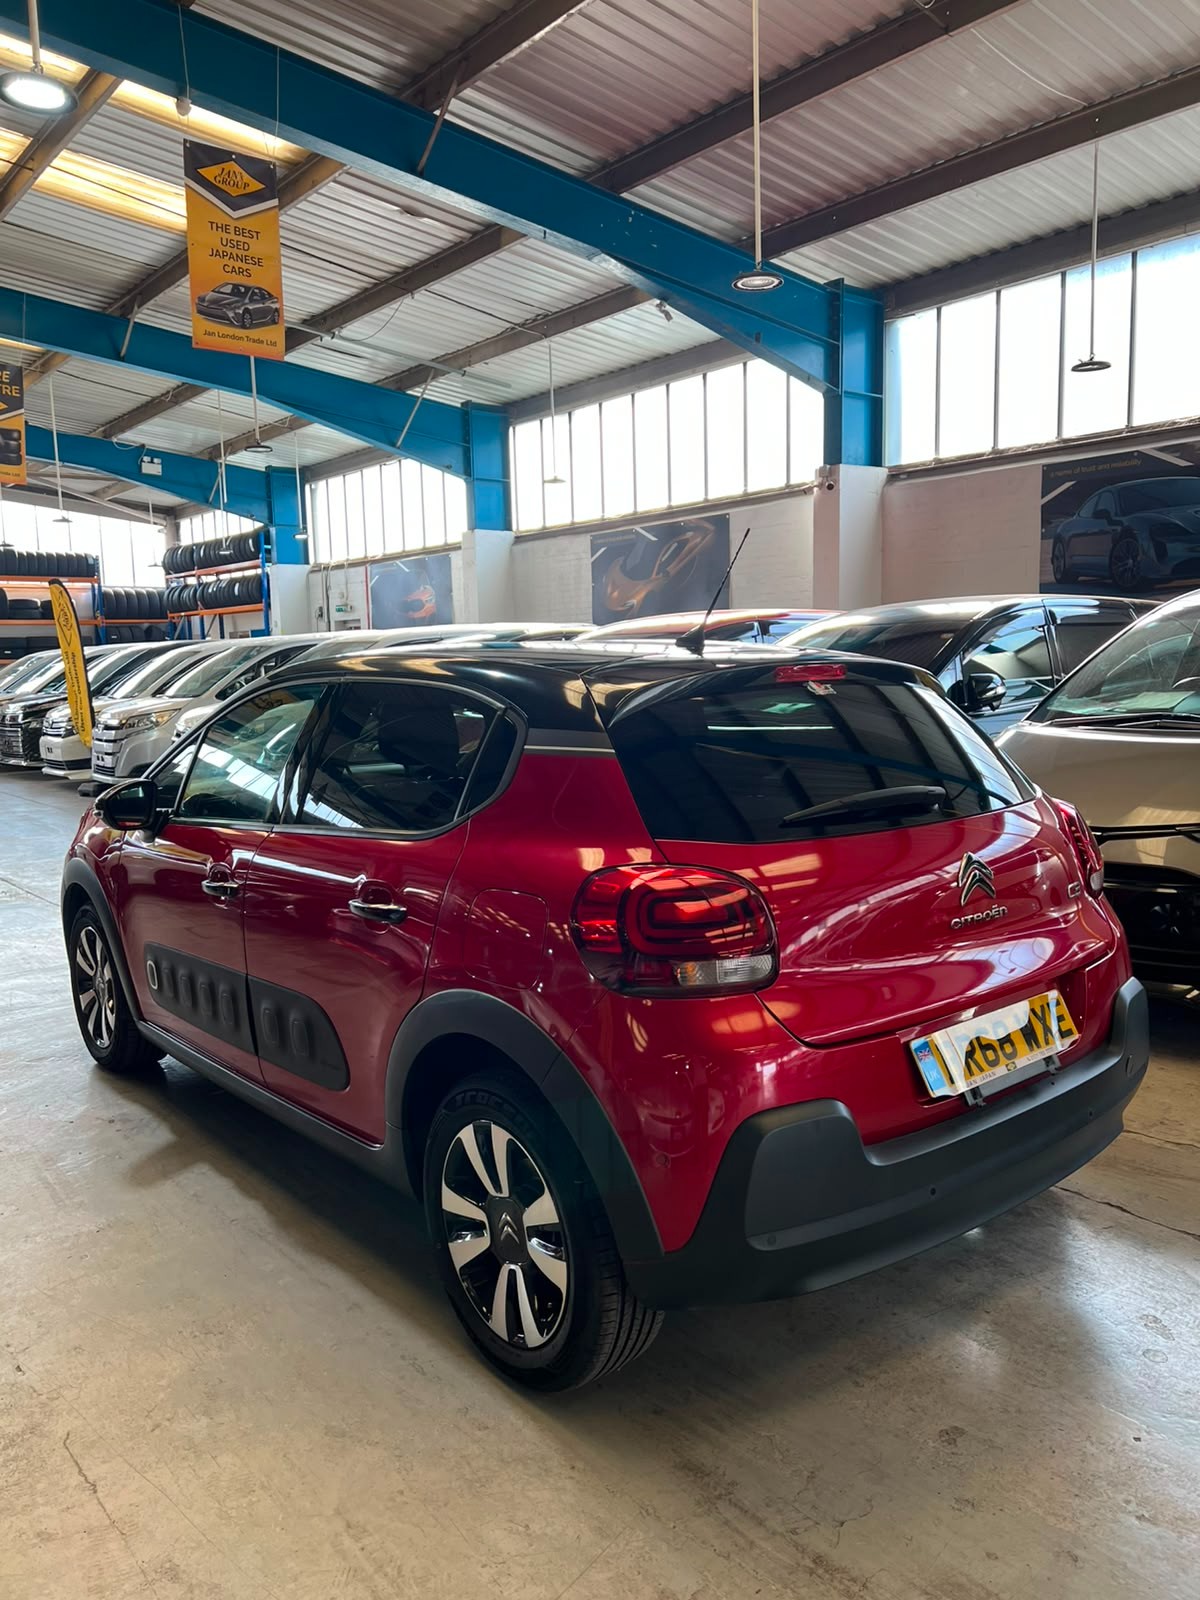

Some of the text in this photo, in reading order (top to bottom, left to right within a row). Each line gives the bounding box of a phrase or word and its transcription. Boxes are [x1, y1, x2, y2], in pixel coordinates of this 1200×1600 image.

[213, 175, 250, 190] GROUP
[208, 220, 261, 241] THE BEST
[220, 237, 250, 252] USED
[208, 247, 264, 267] JAPANESE
[222, 263, 252, 278] CARS
[203, 328, 277, 347] Jan London Trade Ltd
[0, 384, 21, 397] RE
[927, 1069, 940, 1082] UK
